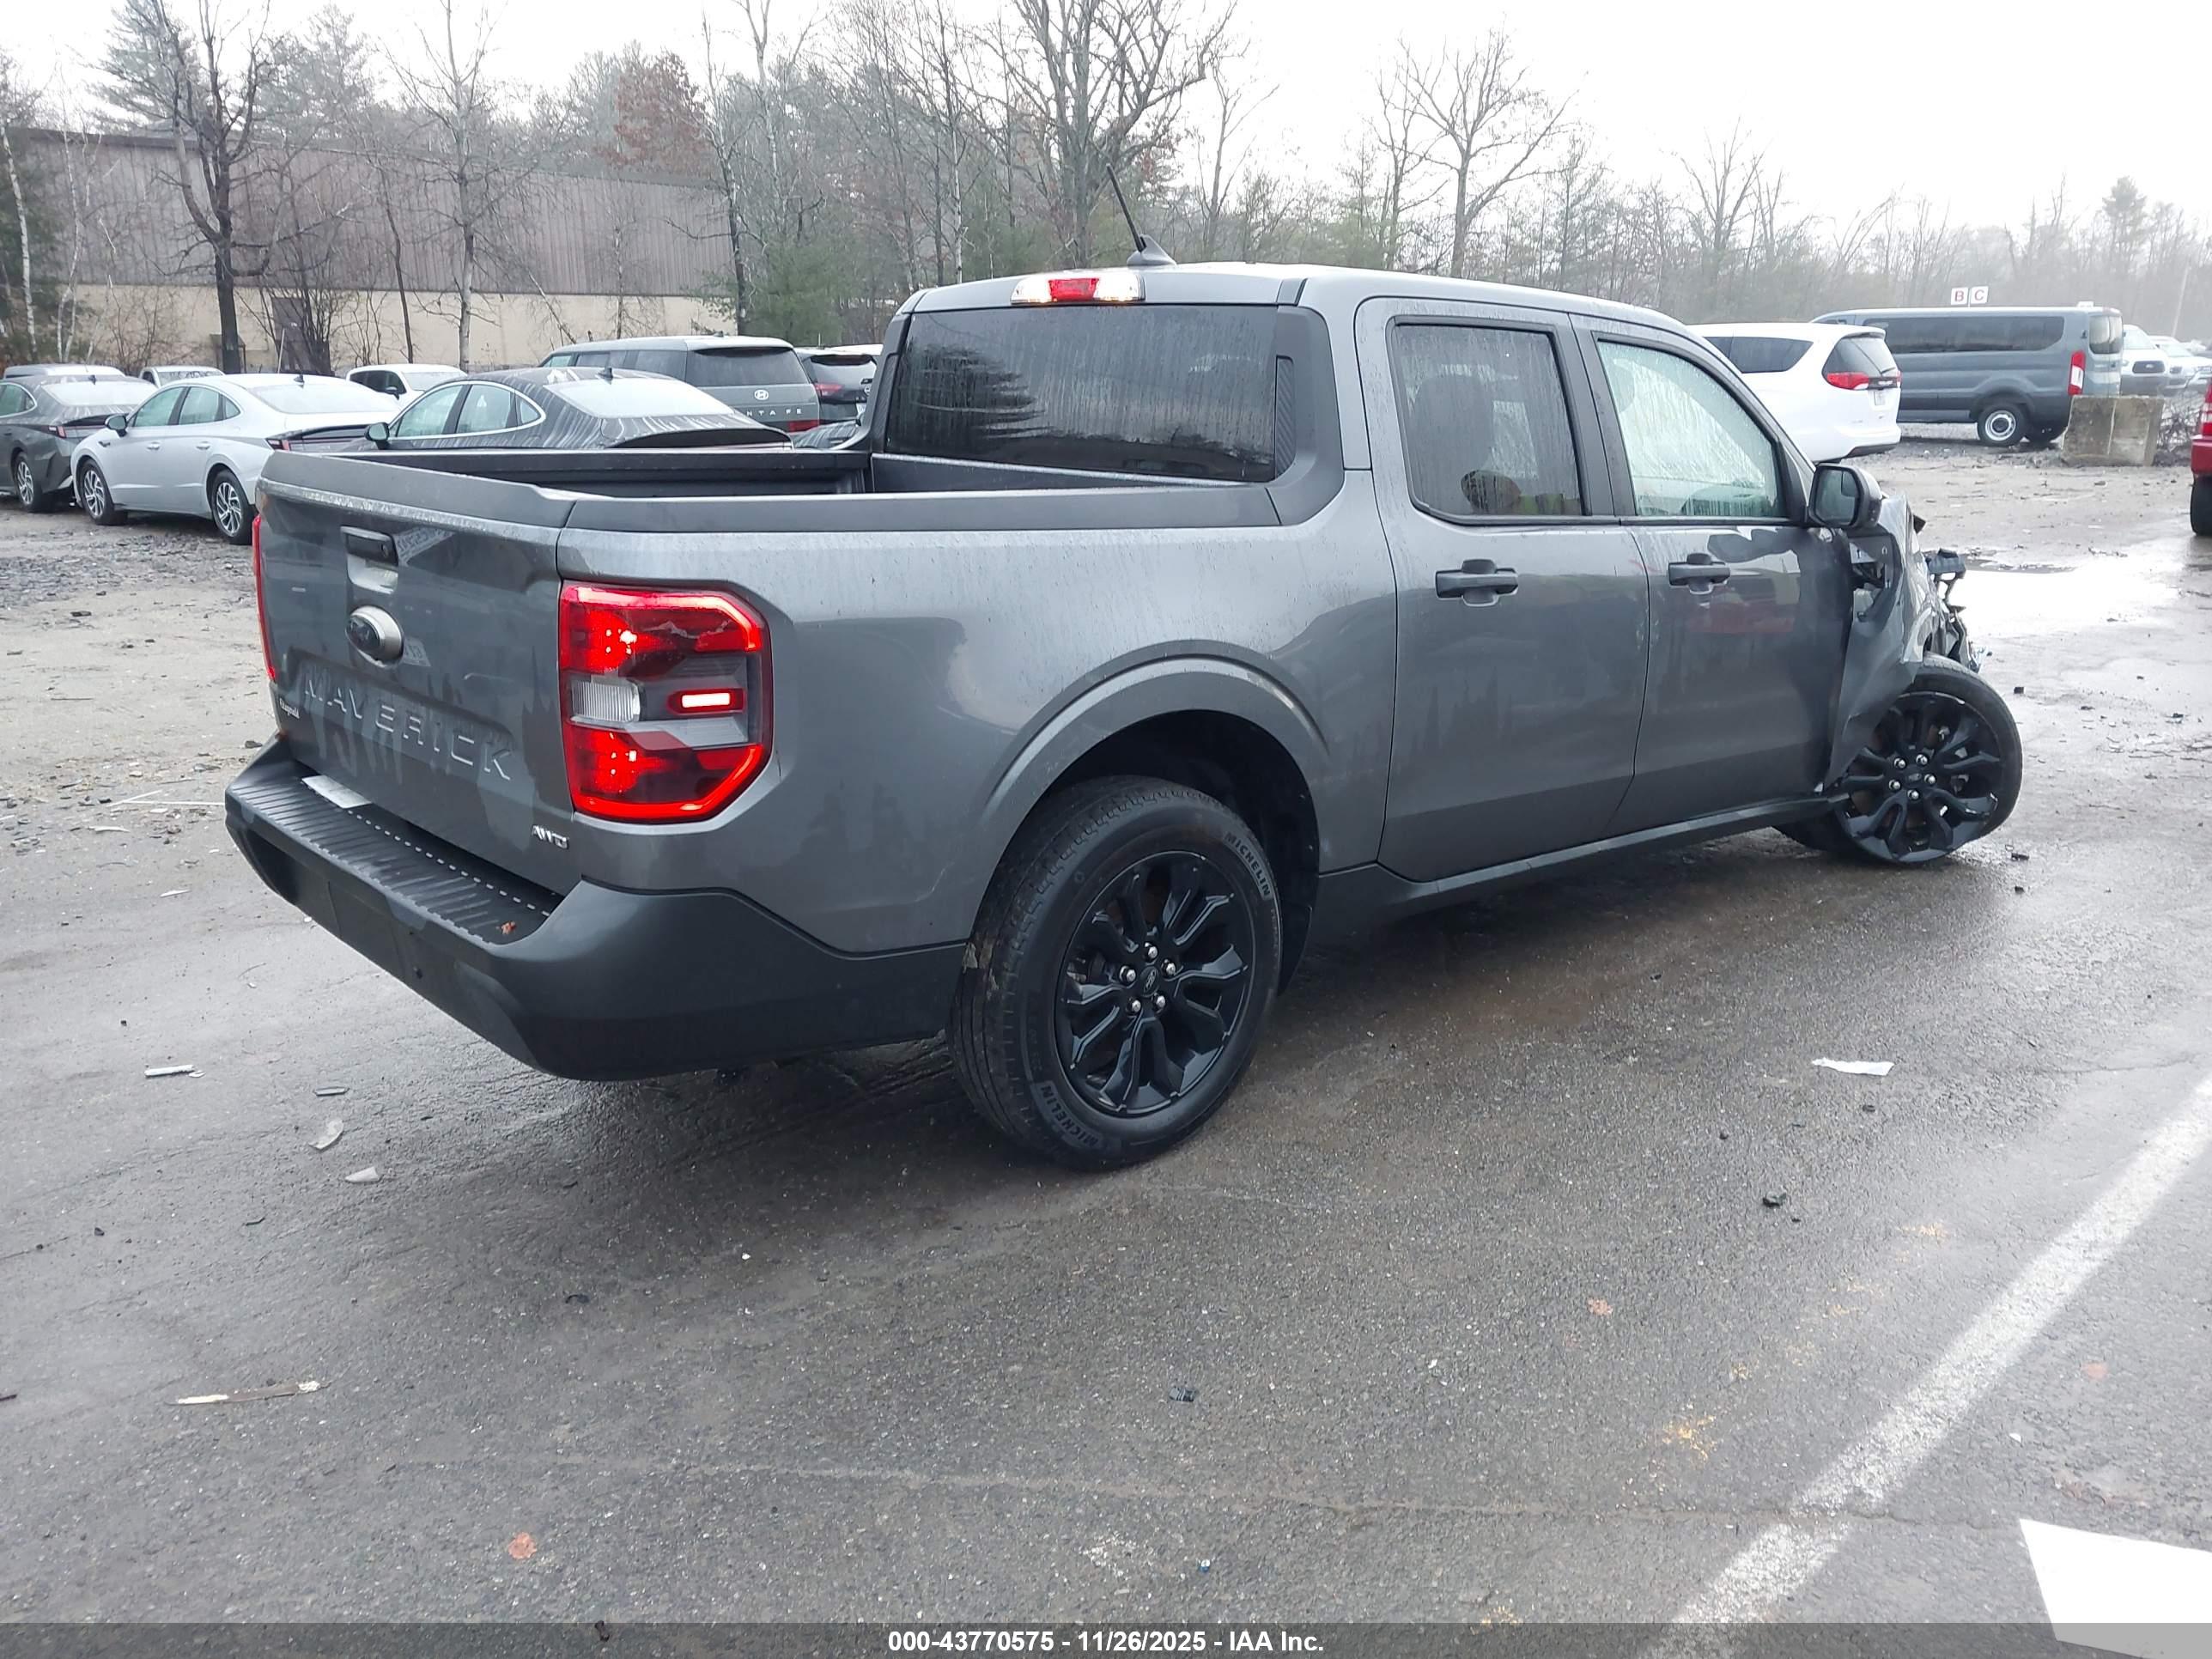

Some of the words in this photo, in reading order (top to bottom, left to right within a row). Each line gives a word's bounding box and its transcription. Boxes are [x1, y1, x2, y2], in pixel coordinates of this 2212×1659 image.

[1954, 290, 1965, 302] B
[1974, 289, 1984, 301] C
[304, 678, 511, 781] MAVERICK
[532, 825, 568, 848] AWD
[1224, 831, 1271, 896] MICHELIN
[1040, 1085, 1100, 1146] MICHELIN
